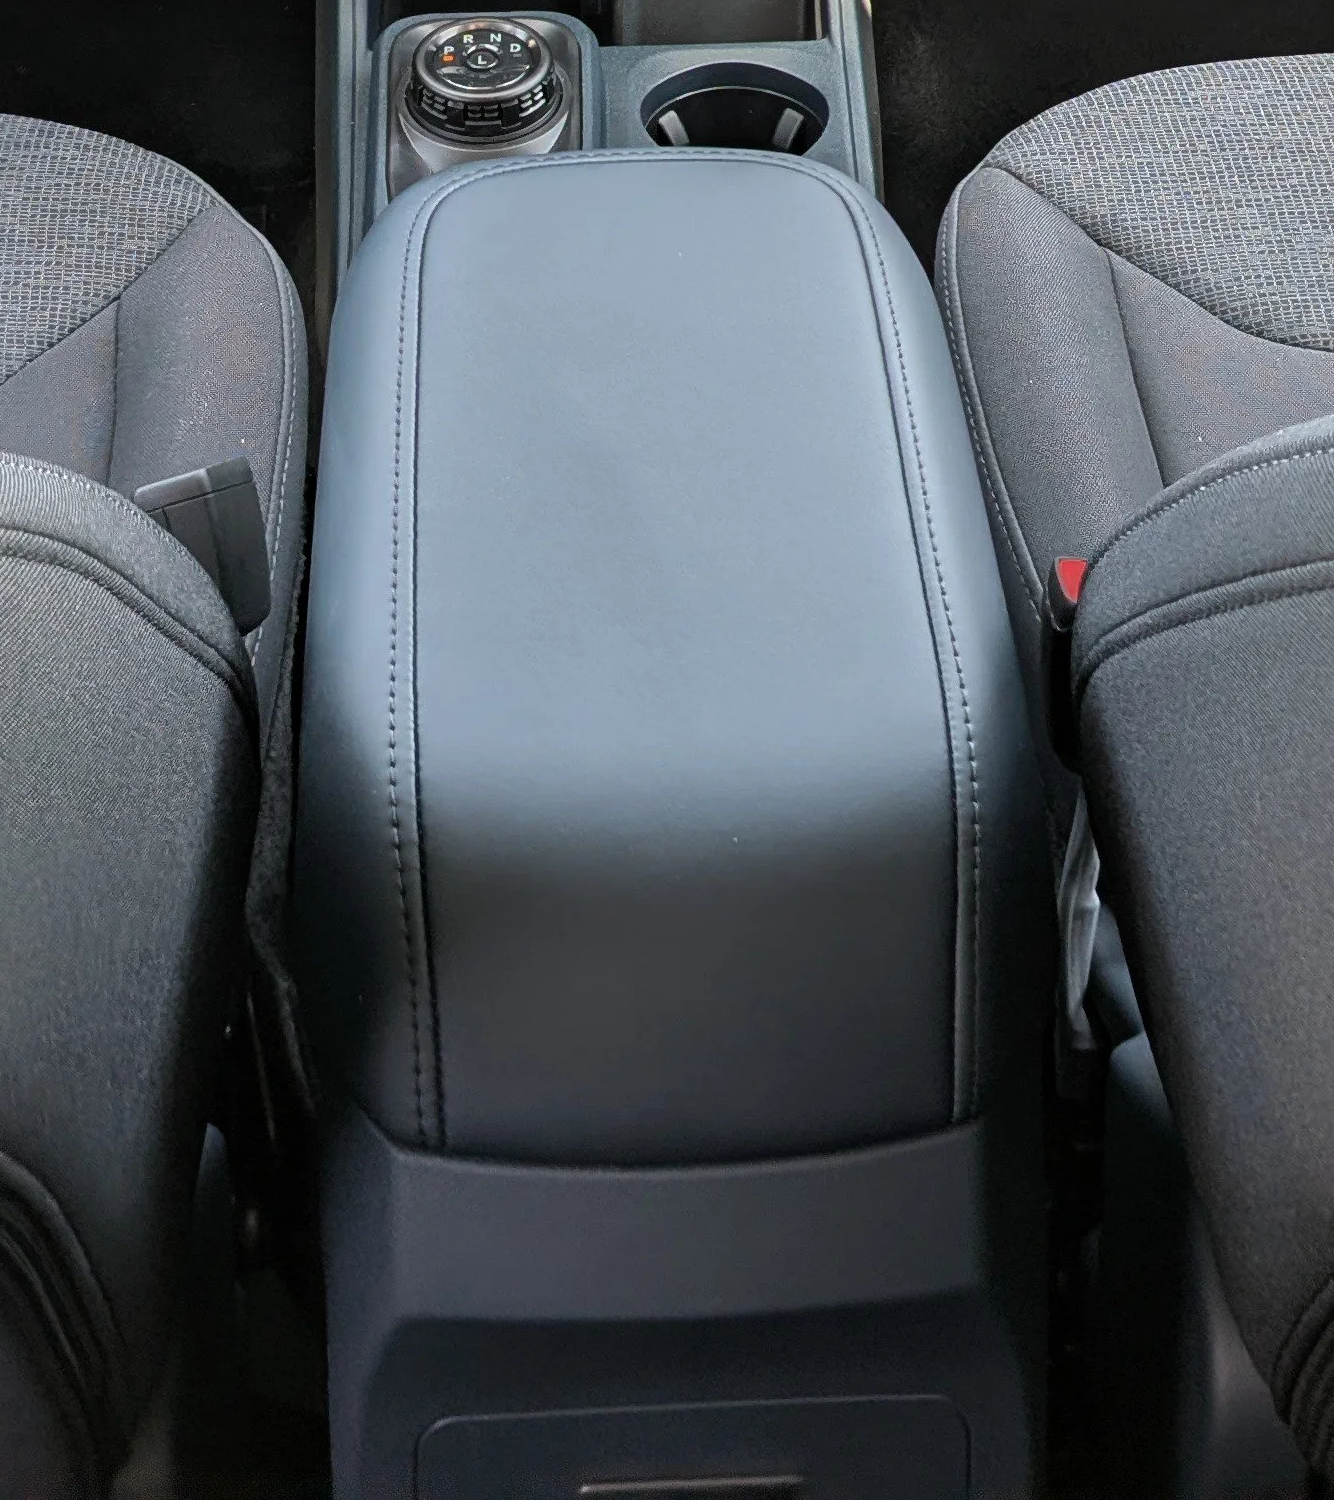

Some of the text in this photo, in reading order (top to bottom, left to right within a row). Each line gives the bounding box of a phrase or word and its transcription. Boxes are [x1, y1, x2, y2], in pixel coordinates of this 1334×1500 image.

[463, 33, 502, 44] R N
[443, 43, 522, 65] P L D
